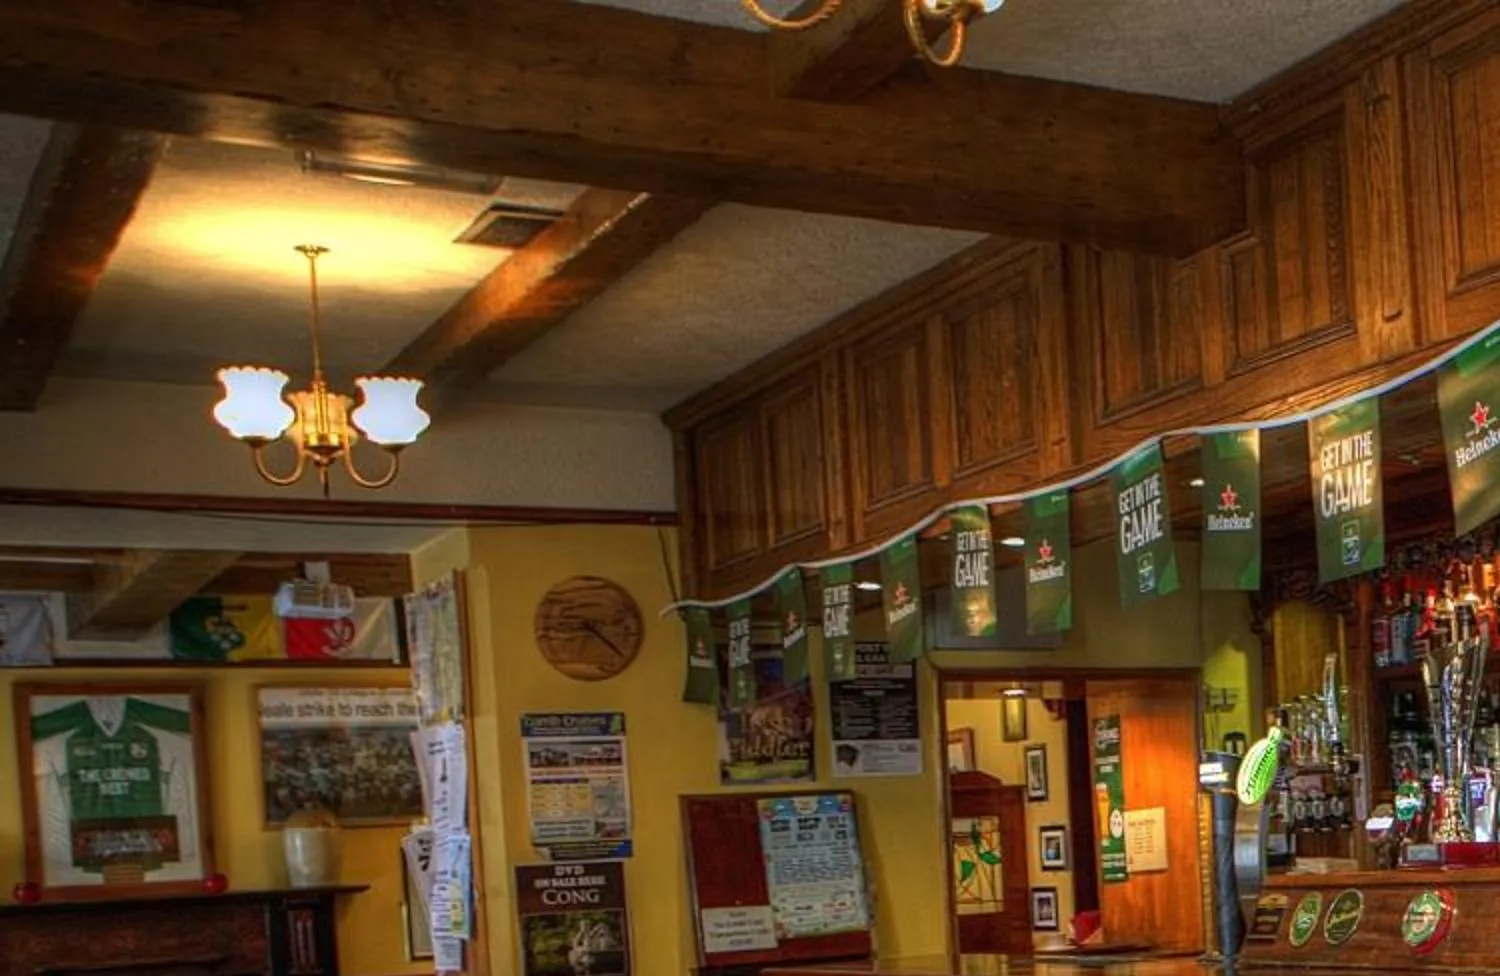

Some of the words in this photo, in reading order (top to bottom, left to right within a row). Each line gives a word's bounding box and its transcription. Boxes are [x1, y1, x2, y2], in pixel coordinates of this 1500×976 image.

[1321, 442, 1340, 472] GET
[1354, 431, 1373, 458] THE
[1321, 460, 1372, 517] GAME
[1121, 499, 1163, 554] GAME
[541, 888, 600, 905] CONG
